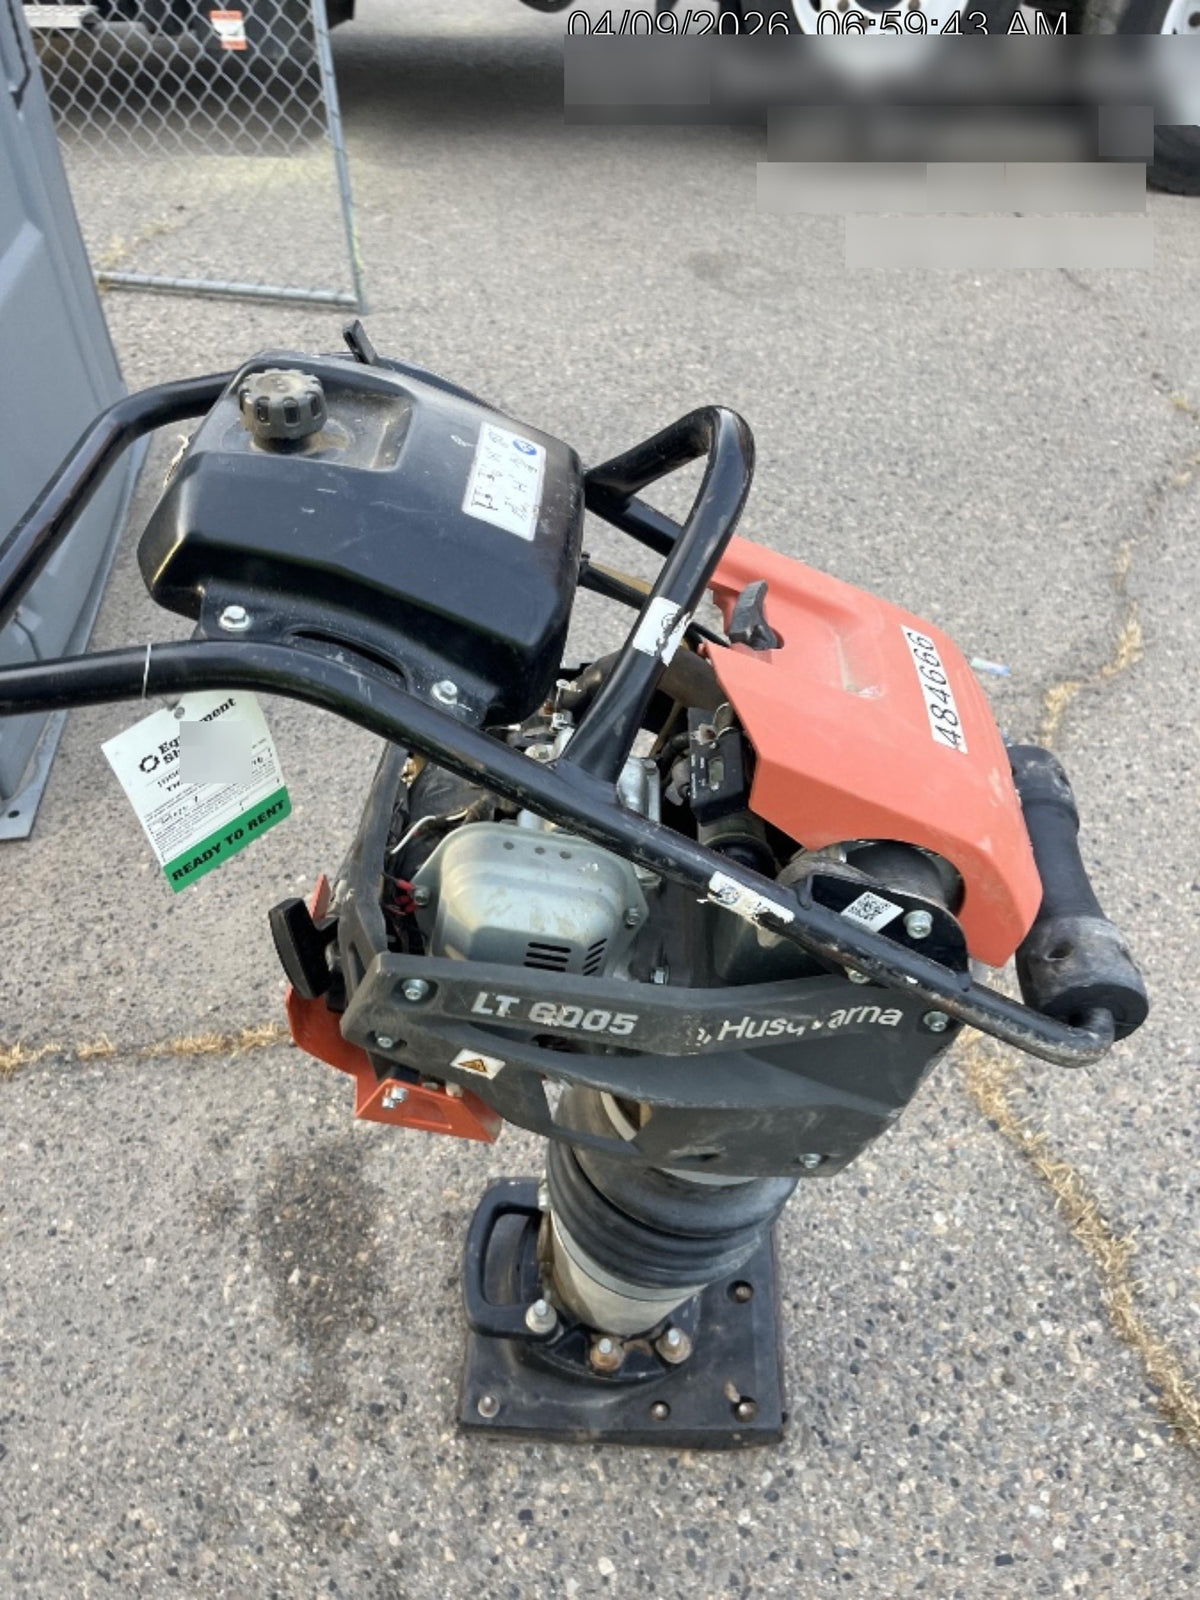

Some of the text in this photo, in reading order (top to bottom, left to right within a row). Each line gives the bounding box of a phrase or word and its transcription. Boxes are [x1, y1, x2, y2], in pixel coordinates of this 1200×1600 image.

[906, 632, 962, 746] 484666
[158, 697, 237, 755] Eqment
[171, 842, 223, 881] READY
[223, 828, 245, 846] TO
[247, 800, 286, 832] RENT
[470, 991, 640, 1036] LT 6005
